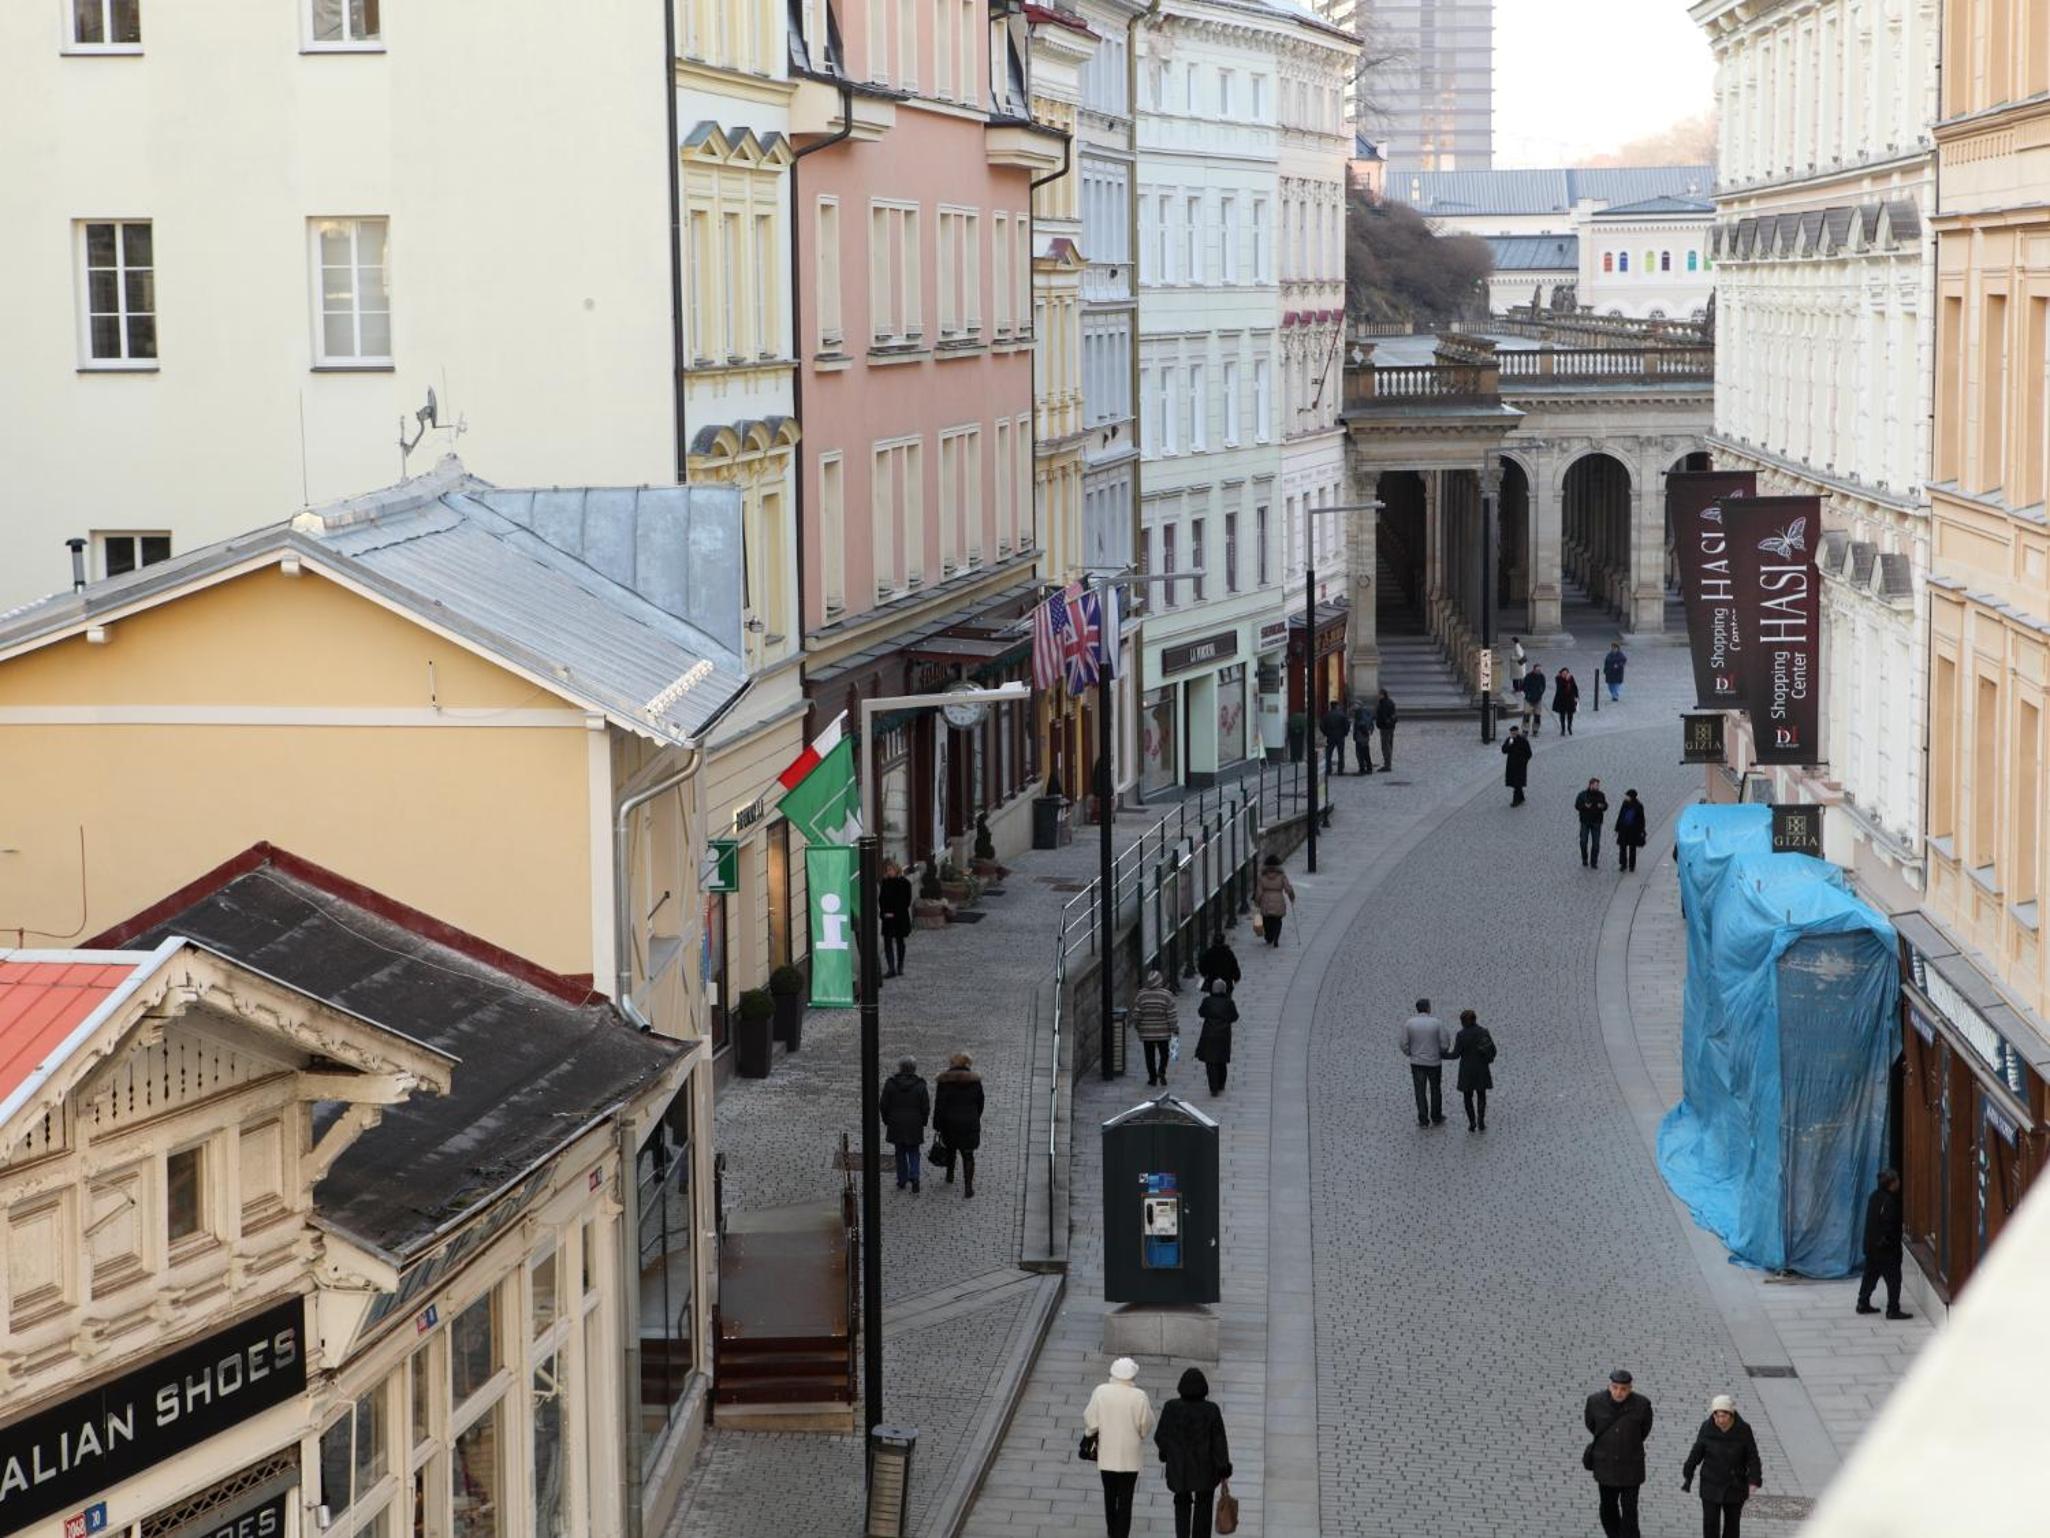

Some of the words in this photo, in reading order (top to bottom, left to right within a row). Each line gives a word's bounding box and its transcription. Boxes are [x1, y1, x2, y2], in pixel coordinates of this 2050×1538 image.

[1759, 565, 1807, 643] HASI
[1711, 608, 1728, 668] Shopping
[1771, 651, 1790, 719] Shopping
[1791, 651, 1807, 700] Center
[1774, 835, 1818, 847] GIZIA
[156, 1328, 296, 1427] SHOES
